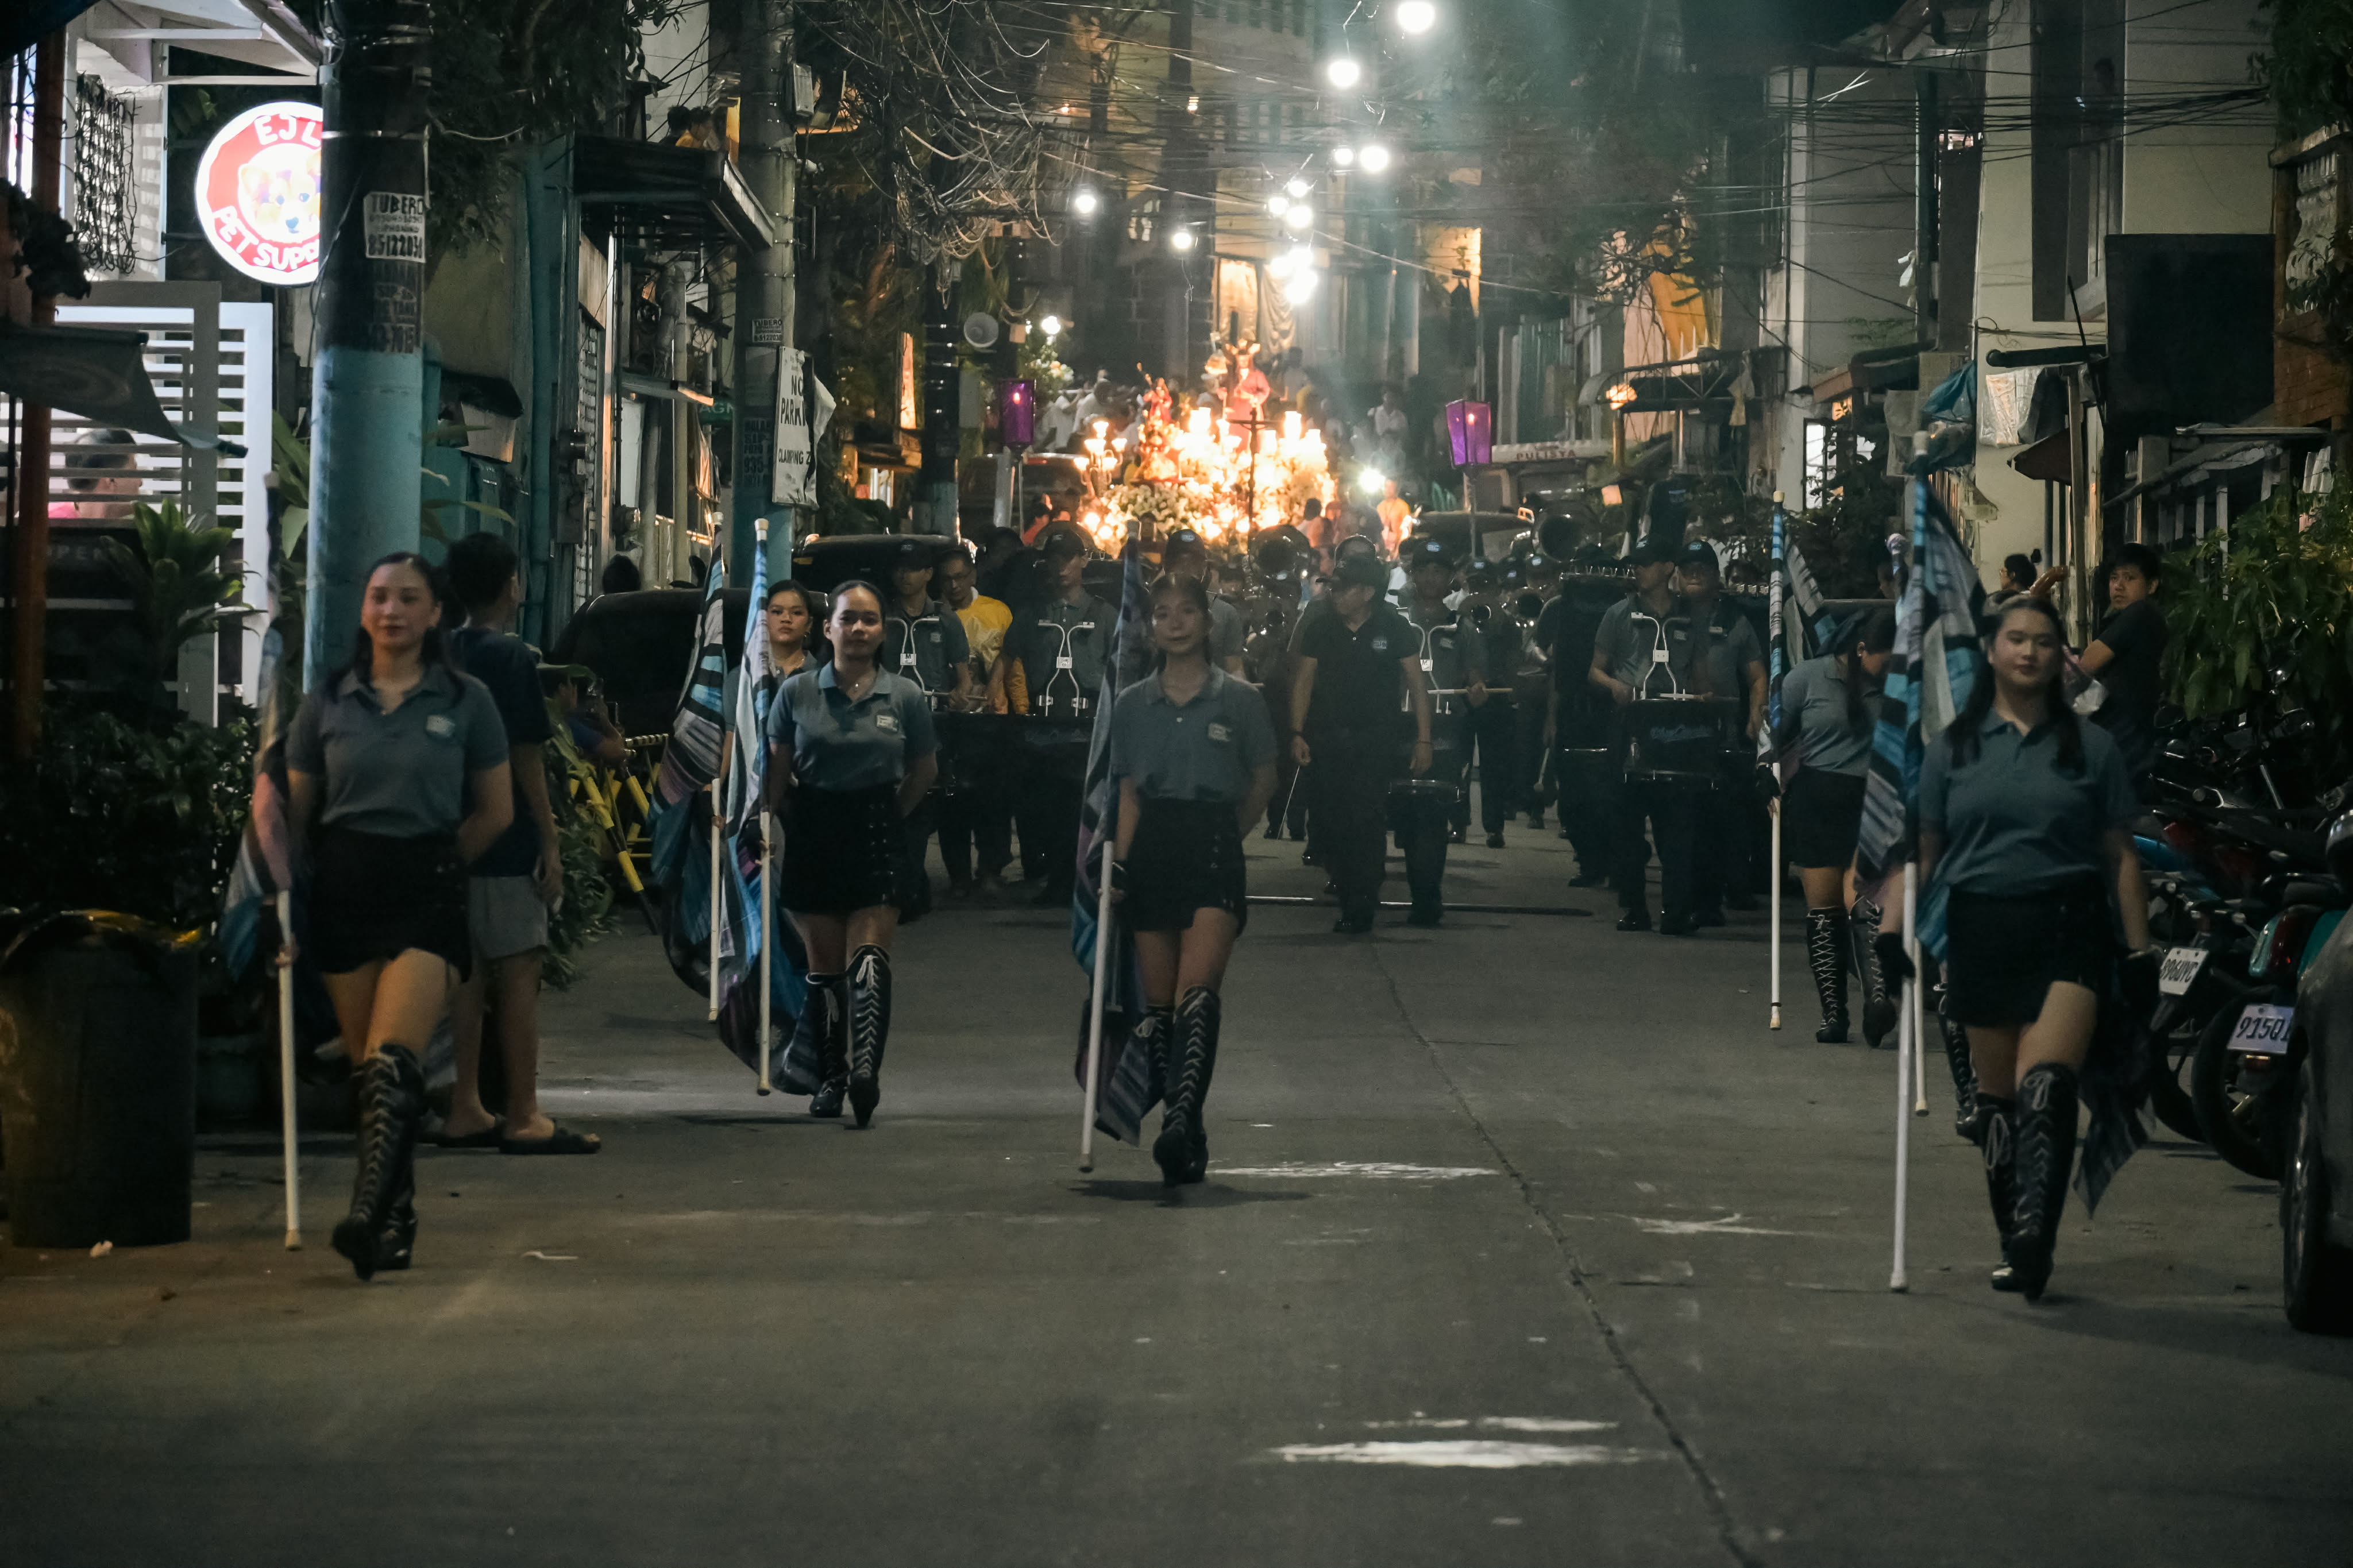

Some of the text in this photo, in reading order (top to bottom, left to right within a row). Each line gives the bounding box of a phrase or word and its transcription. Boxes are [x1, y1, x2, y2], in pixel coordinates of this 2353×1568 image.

[371, 194, 424, 215] TUBERO
[212, 206, 260, 254] PET
[791, 374, 804, 397] NO
[778, 448, 804, 465] CLAMPING
